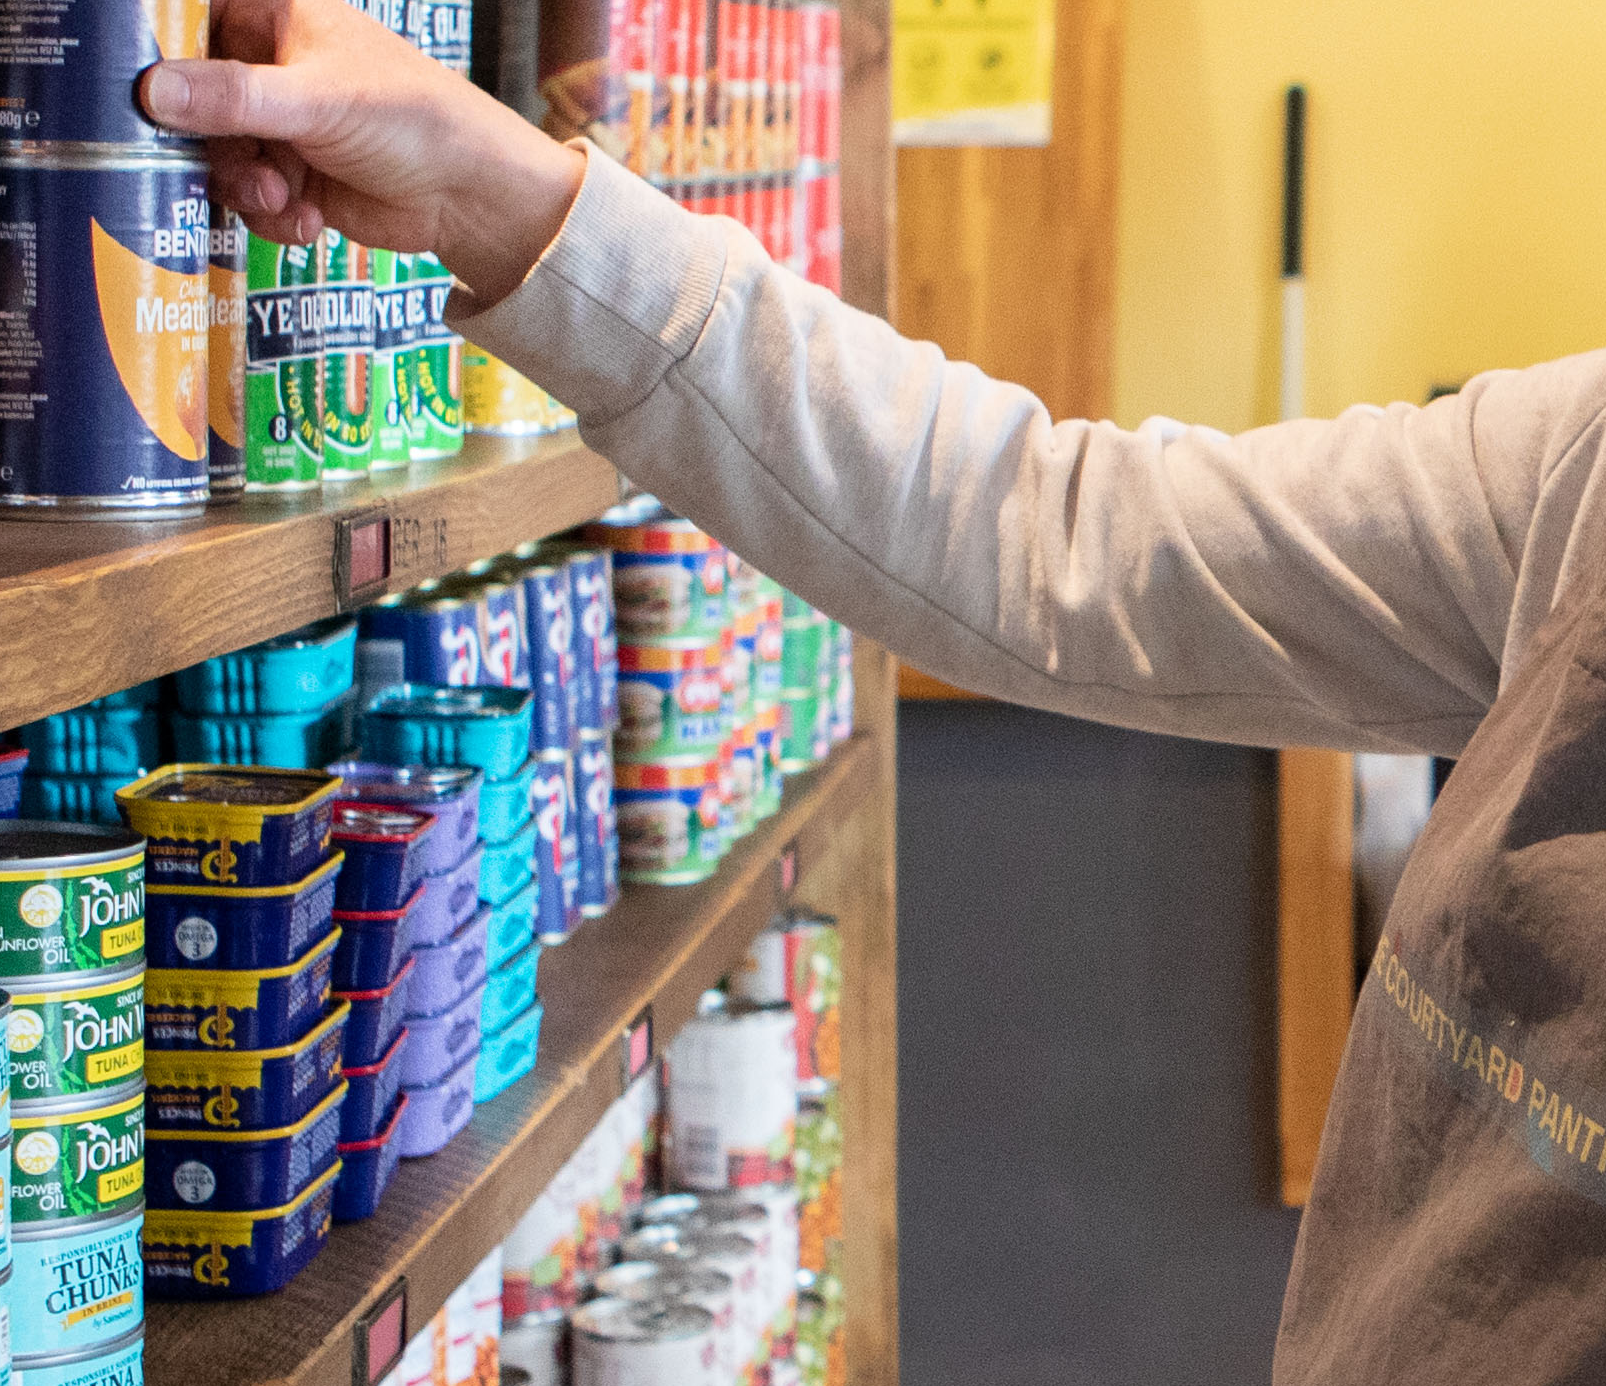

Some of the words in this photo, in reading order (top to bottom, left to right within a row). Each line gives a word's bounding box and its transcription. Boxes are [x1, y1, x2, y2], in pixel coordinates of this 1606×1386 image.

[252, 297, 294, 337] YE
[273, 420, 288, 444] 8
[80, 891, 140, 938] JOHN
[109, 928, 137, 951] TUNA
[43, 947, 71, 965] OIL
[63, 1011, 133, 1064] JOHN
[1385, 953, 1525, 1104] COURTYARD
[95, 1052, 129, 1075] TUNA
[23, 1072, 52, 1090] OIL
[76, 1132, 138, 1184] JOHN
[106, 1173, 136, 1194] TUNA
[39, 1194, 67, 1212] OIL
[40, 1236, 103, 1267] RESPONSIBLY
[52, 1243, 129, 1289] TUNA
[45, 1260, 140, 1315] CHUNKS
